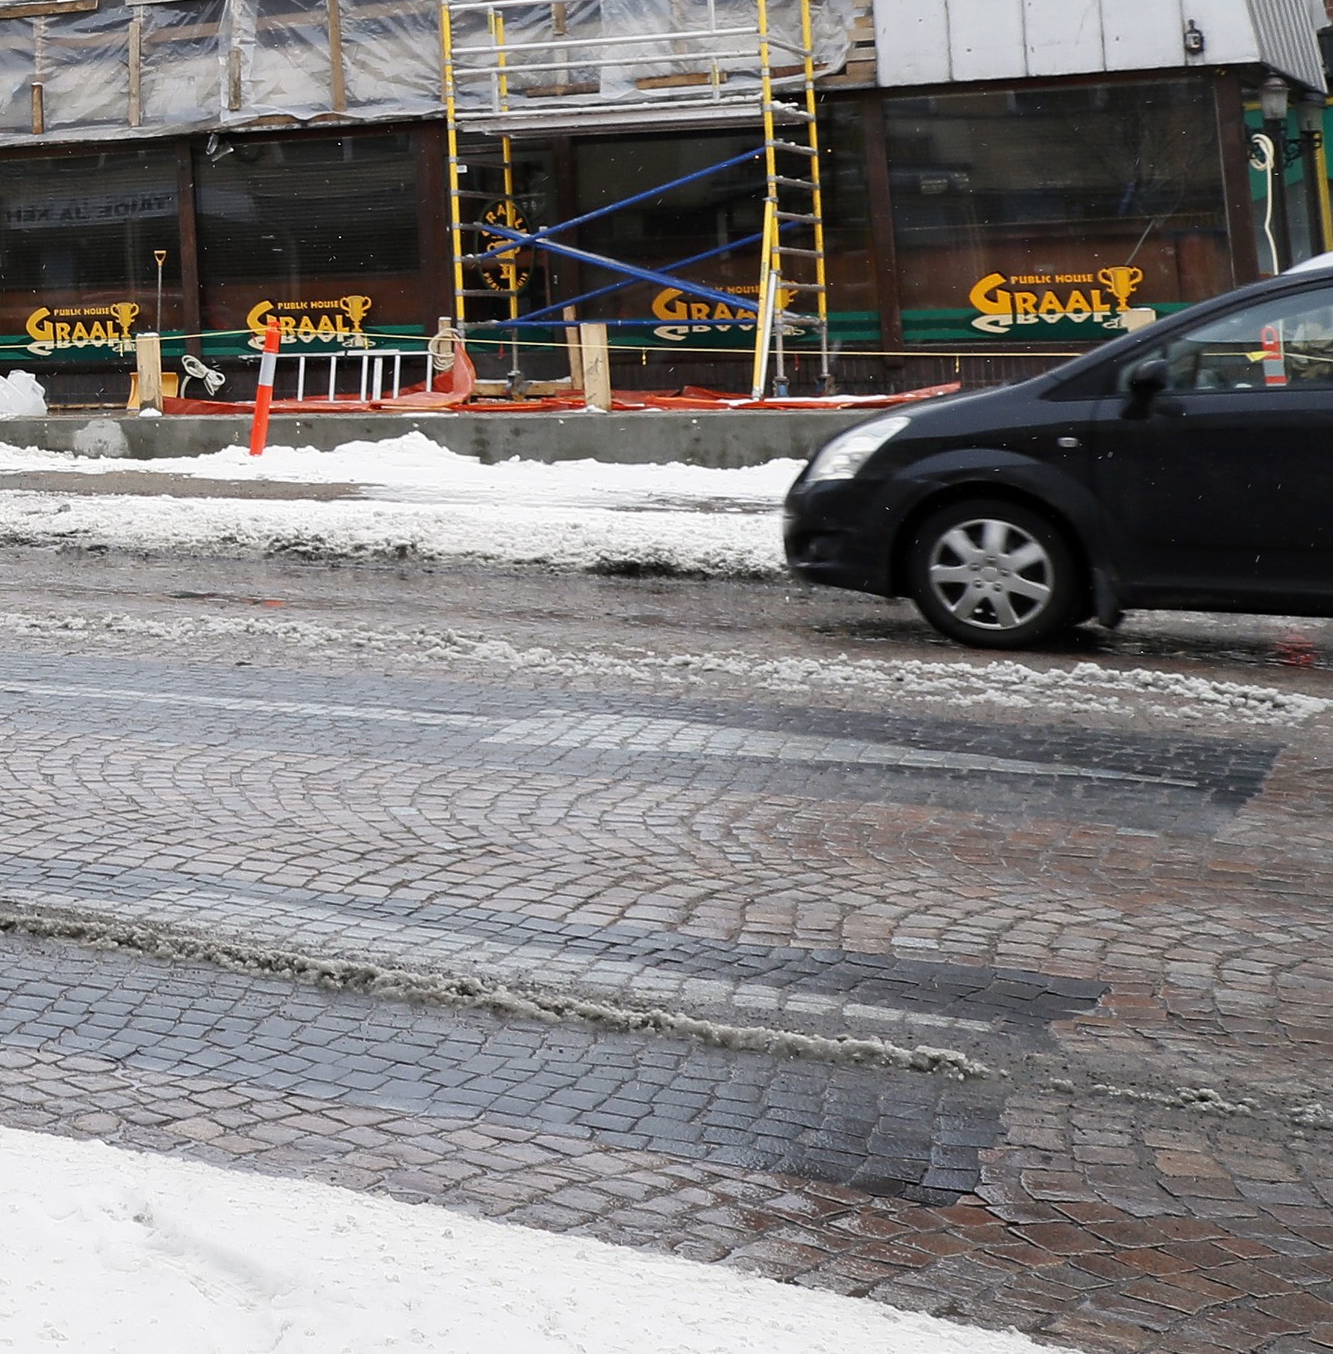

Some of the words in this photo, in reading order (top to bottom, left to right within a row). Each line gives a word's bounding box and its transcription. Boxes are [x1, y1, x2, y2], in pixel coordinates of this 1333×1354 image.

[1010, 275, 1051, 285] PUBLIC
[1056, 274, 1094, 283] HOUSE
[277, 301, 308, 310] PUBLIC
[310, 300, 338, 309] HOUSE
[652, 287, 758, 321] GRAA
[969, 273, 1111, 315] GRAAL
[54, 308, 80, 316] PUBLIC
[83, 307, 109, 315] HOUSE
[26, 307, 120, 340] GRAAL
